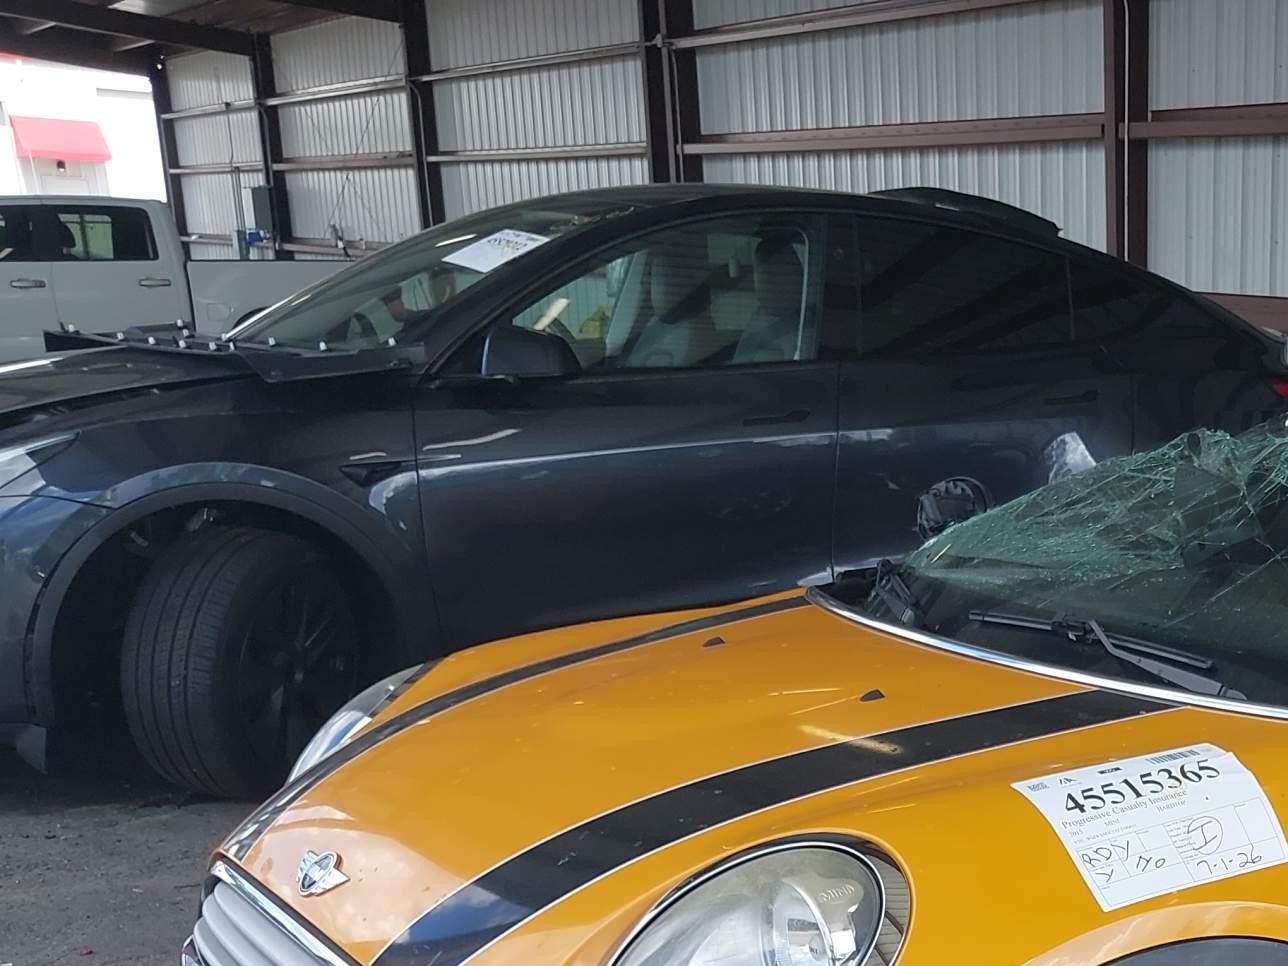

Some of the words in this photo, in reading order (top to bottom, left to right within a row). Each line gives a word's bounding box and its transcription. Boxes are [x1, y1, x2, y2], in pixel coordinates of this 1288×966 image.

[1061, 809, 1112, 830] Progressive
[1112, 798, 1148, 815] Casualty
[1148, 789, 1188, 805] Insurance
[1065, 758, 1220, 813] 45515365
